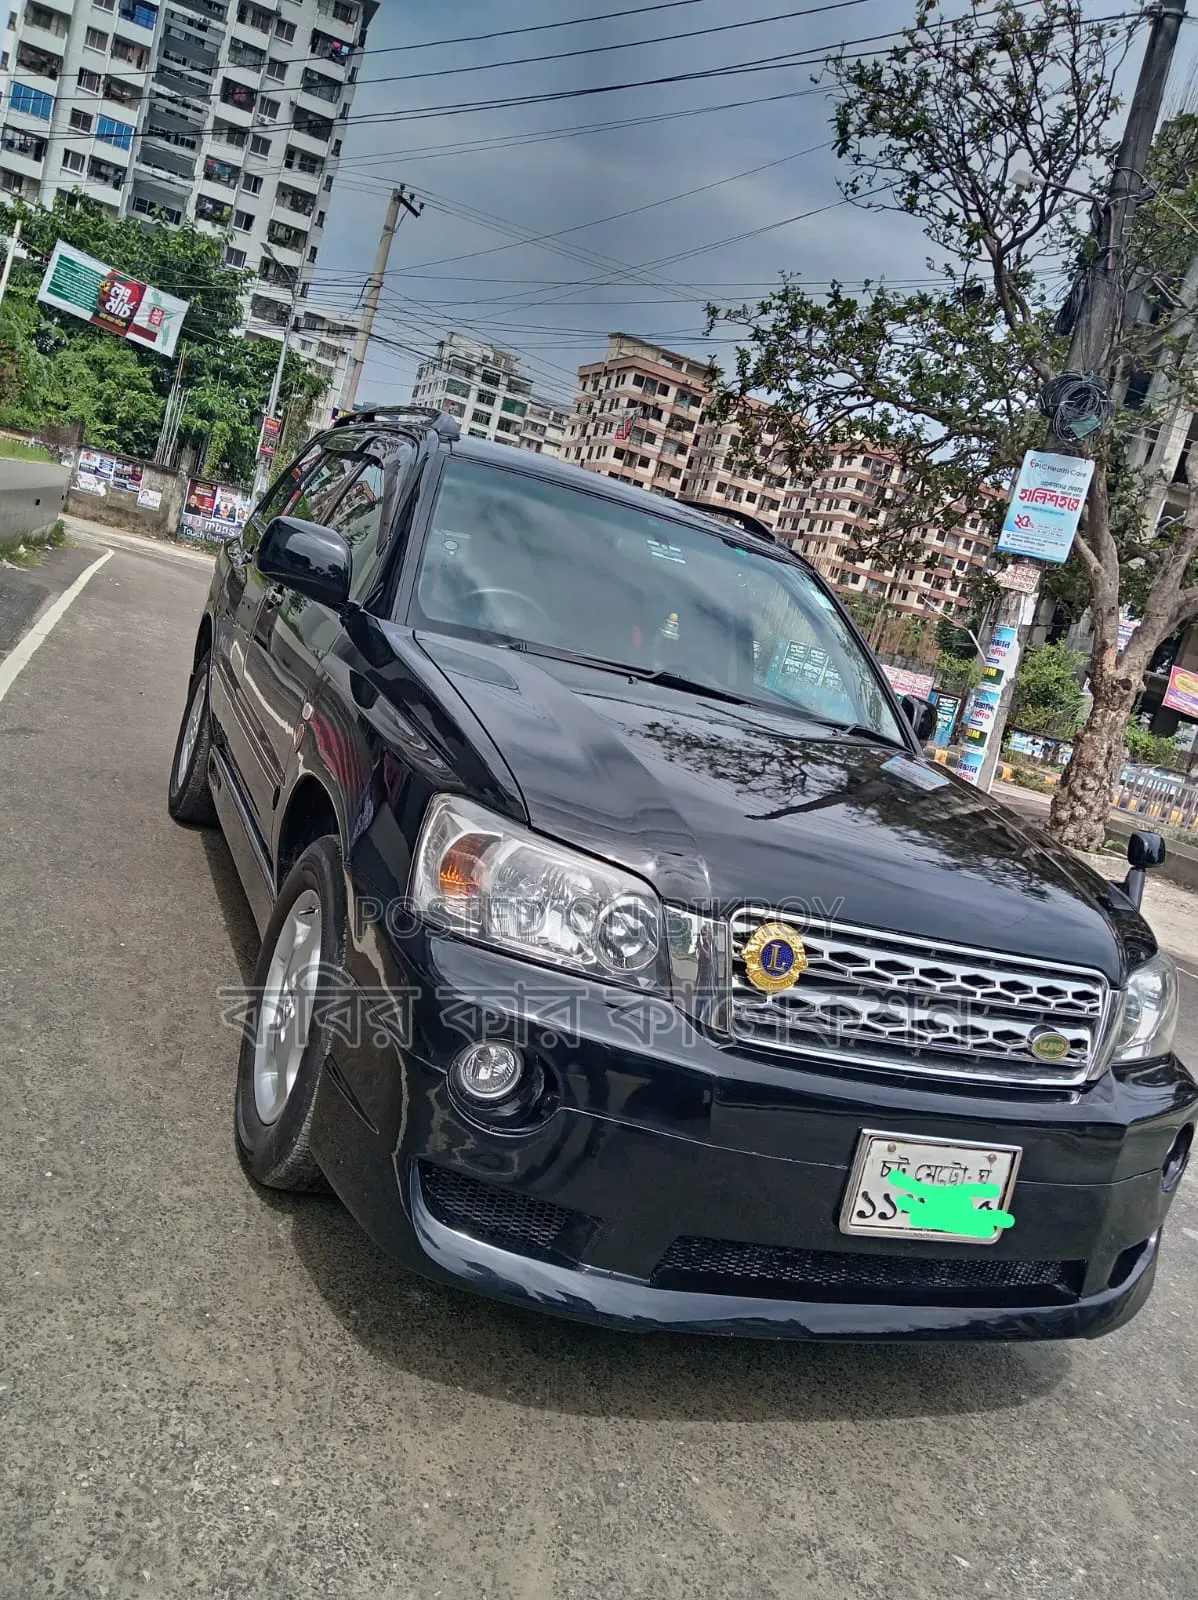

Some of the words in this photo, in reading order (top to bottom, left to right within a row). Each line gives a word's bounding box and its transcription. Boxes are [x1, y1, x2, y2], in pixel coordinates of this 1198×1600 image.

[1047, 464, 1070, 475] Health
[1070, 470, 1087, 478] Care
[1018, 487, 1081, 512] হালিশহরে
[767, 943, 787, 972] L
